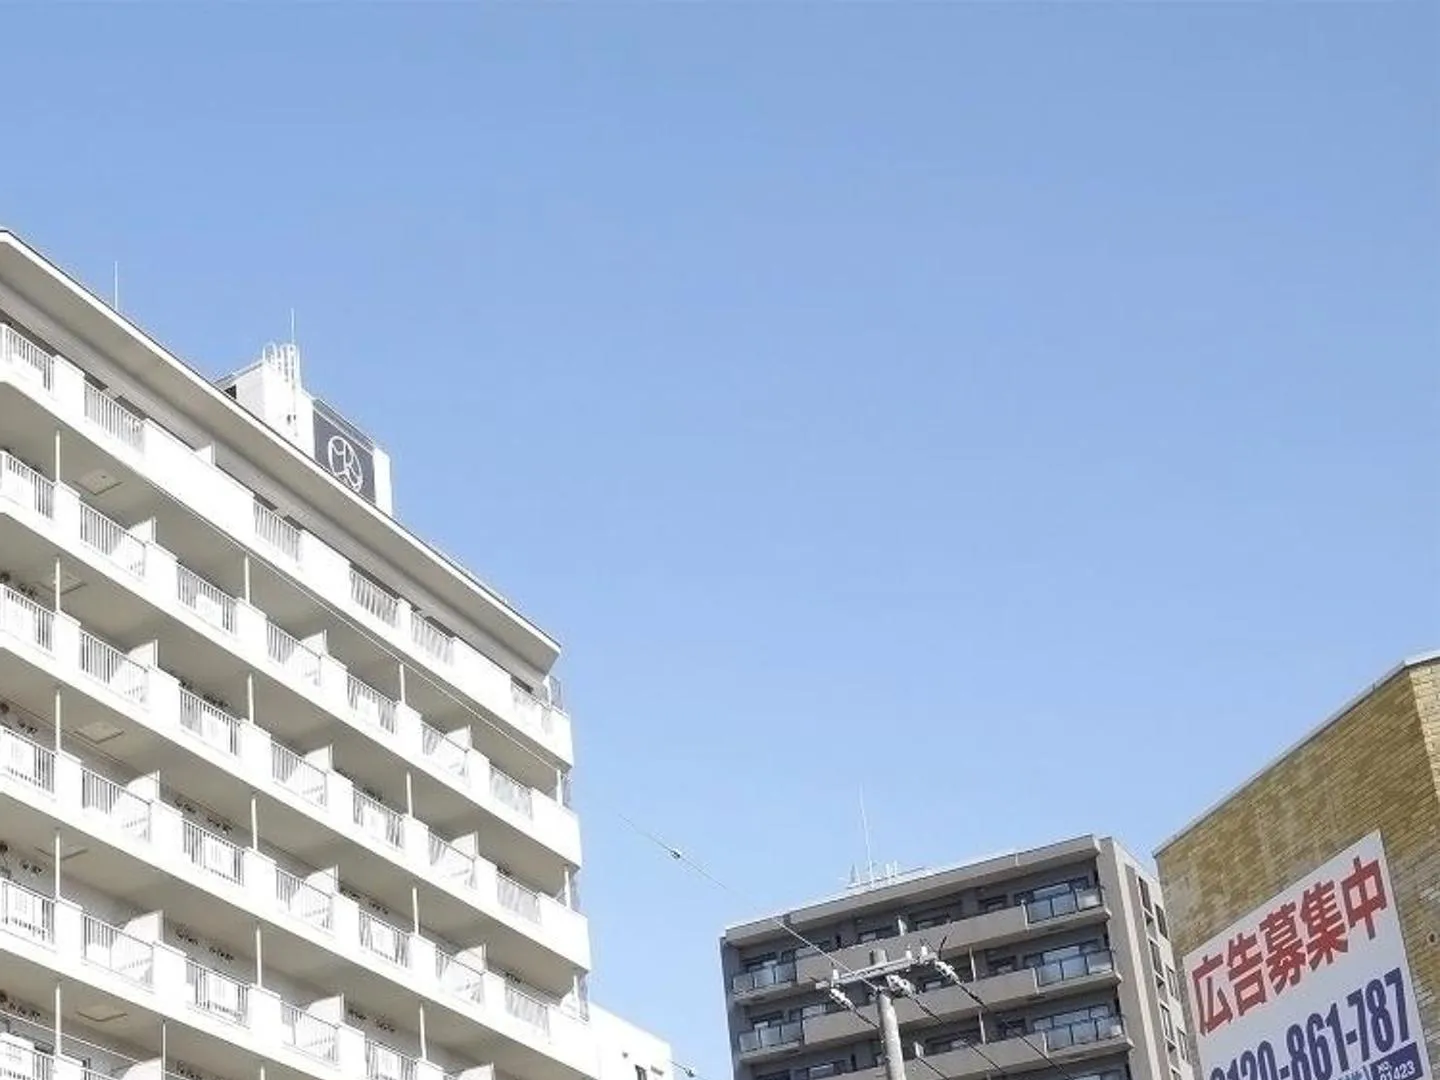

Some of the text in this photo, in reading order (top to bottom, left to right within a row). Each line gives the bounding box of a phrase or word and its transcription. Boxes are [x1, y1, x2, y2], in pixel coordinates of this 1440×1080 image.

[1192, 856, 1387, 1036] 広告募集中
